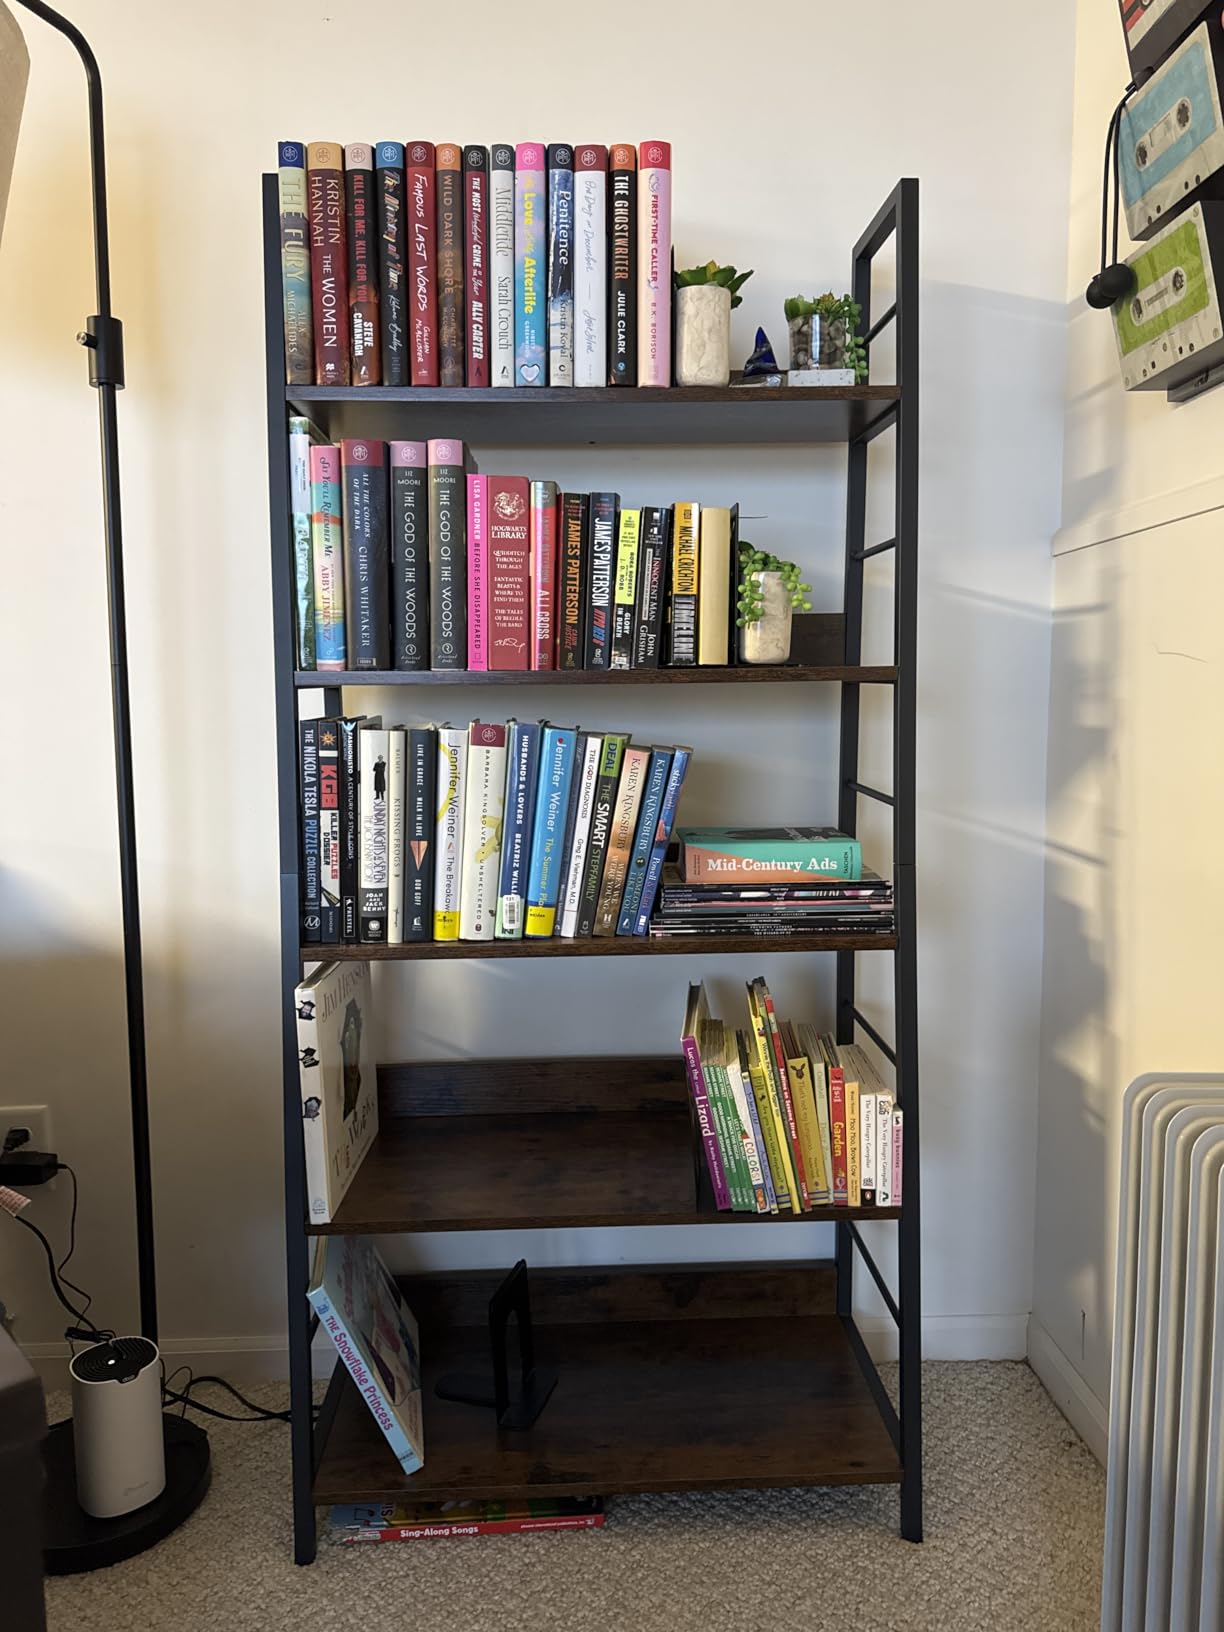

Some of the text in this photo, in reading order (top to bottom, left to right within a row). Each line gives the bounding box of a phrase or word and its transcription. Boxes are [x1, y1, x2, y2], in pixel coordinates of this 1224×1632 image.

[282, 178, 305, 282] THE FURY
[311, 176, 324, 247] HANNAH
[326, 179, 340, 243] KRISTIN
[353, 175, 368, 301] KILL FOR KILL FOR YOU
[443, 175, 454, 294] WILD DARK SHORE
[472, 177, 482, 267] THE MOST CRIME
[495, 188, 512, 256] Middletide
[558, 190, 571, 265] Penitence
[614, 176, 629, 279] THE GHOSTWRITER
[650, 194, 658, 245] FIRST-TIME
[415, 224, 429, 311] LAST WORDS
[524, 256, 536, 314] Afterlife
[321, 254, 336, 347] THE WOMEN
[498, 276, 511, 349] Sarah Crouch
[617, 291, 626, 353] JULIE CLARK
[353, 312, 363, 356] CAVANAGH
[364, 321, 373, 347] STEVE
[472, 301, 484, 359] ALLY CARTER
[560, 301, 569, 358] Kristin Koval
[473, 480, 481, 498] LISA
[363, 506, 371, 538] COLORS
[568, 519, 581, 555] JAMES
[594, 518, 612, 552] JAMES
[404, 492, 416, 638] THE GOD OF THE WOODS
[440, 490, 452, 637] THE GOD OF THE WOODS
[592, 554, 610, 606] PATTERSON
[650, 557, 661, 600] INNOCENT
[678, 526, 694, 592] MICHAEL CRICHTON
[321, 565, 331, 641] ABBY JIMENEZ
[358, 546, 370, 646] CHRIS WHITAKER
[566, 559, 580, 624] PATTERSON
[537, 611, 550, 639] CROSS
[623, 613, 631, 634] GLORY
[638, 625, 647, 663] GRISHAM
[647, 634, 656, 656] JOHN
[674, 597, 694, 660] TIMELINE
[519, 735, 529, 782] HUSBANDS
[581, 750, 596, 819] THE GOD DIAGNOSIS
[604, 743, 617, 772] DEAL
[304, 730, 317, 898] THE NIKOLA TESLA PUZZLE COLLECTION
[321, 765, 337, 808] KGB
[447, 743, 461, 838] Jennifer Weiner
[516, 792, 524, 825] LOVERS
[546, 743, 566, 832] Jennifer Weiner
[615, 758, 641, 852] KAREN KINGSBURY
[638, 759, 665, 852] KAREN KINGSBURY
[374, 800, 386, 883] SUNDAY NIGHTS SEVEN
[393, 799, 401, 835] KISSING
[480, 794, 488, 847] KINGSOLVER
[585, 784, 611, 901] THE SMART STEPFAMILY
[446, 856, 455, 872] The
[513, 833, 521, 868] BEATRIZ
[540, 838, 553, 889] The Summer
[574, 839, 584, 853] Greg
[707, 858, 803, 872] Mid-Century
[807, 858, 838, 870] Ads
[476, 859, 484, 920] UNSHELTERED
[602, 855, 619, 910] WERE YOUNG
[615, 863, 625, 890] WHEN
[622, 872, 637, 913] LIKE YOU
[629, 872, 644, 914] SOMEONE
[687, 1048, 696, 1067] Lucas
[695, 1096, 715, 1136] Lizard
[833, 1122, 844, 1156] Garden
[745, 1142, 760, 1181] COLORS!
[326, 1315, 394, 1430] THE Snowflake Princess
[400, 1525, 479, 1538] Sing-Along Songs
